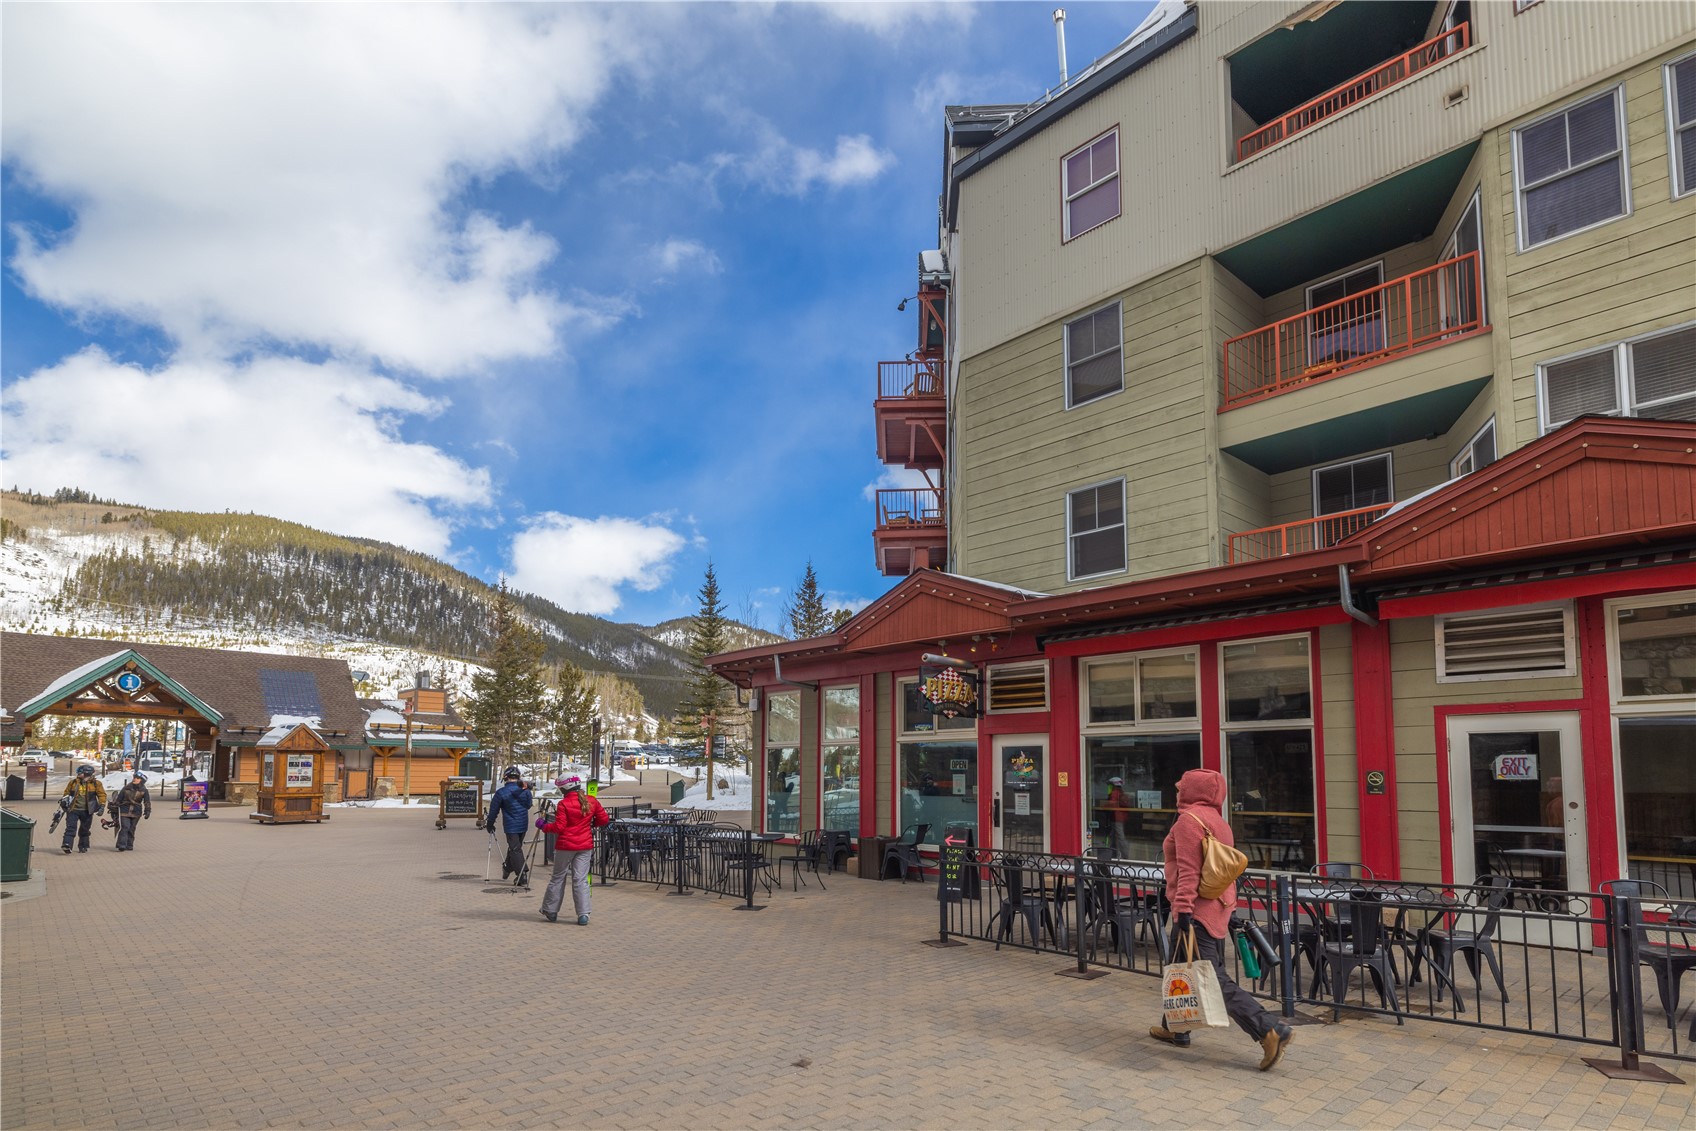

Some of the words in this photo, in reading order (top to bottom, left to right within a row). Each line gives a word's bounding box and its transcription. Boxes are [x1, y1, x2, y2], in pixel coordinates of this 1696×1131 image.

[926, 677, 975, 702] PIZZA
[951, 760, 967, 769] OPEN
[1502, 757, 1528, 767] EXIT
[1500, 766, 1531, 776] ONLY
[1175, 996, 1199, 1008] COMES
